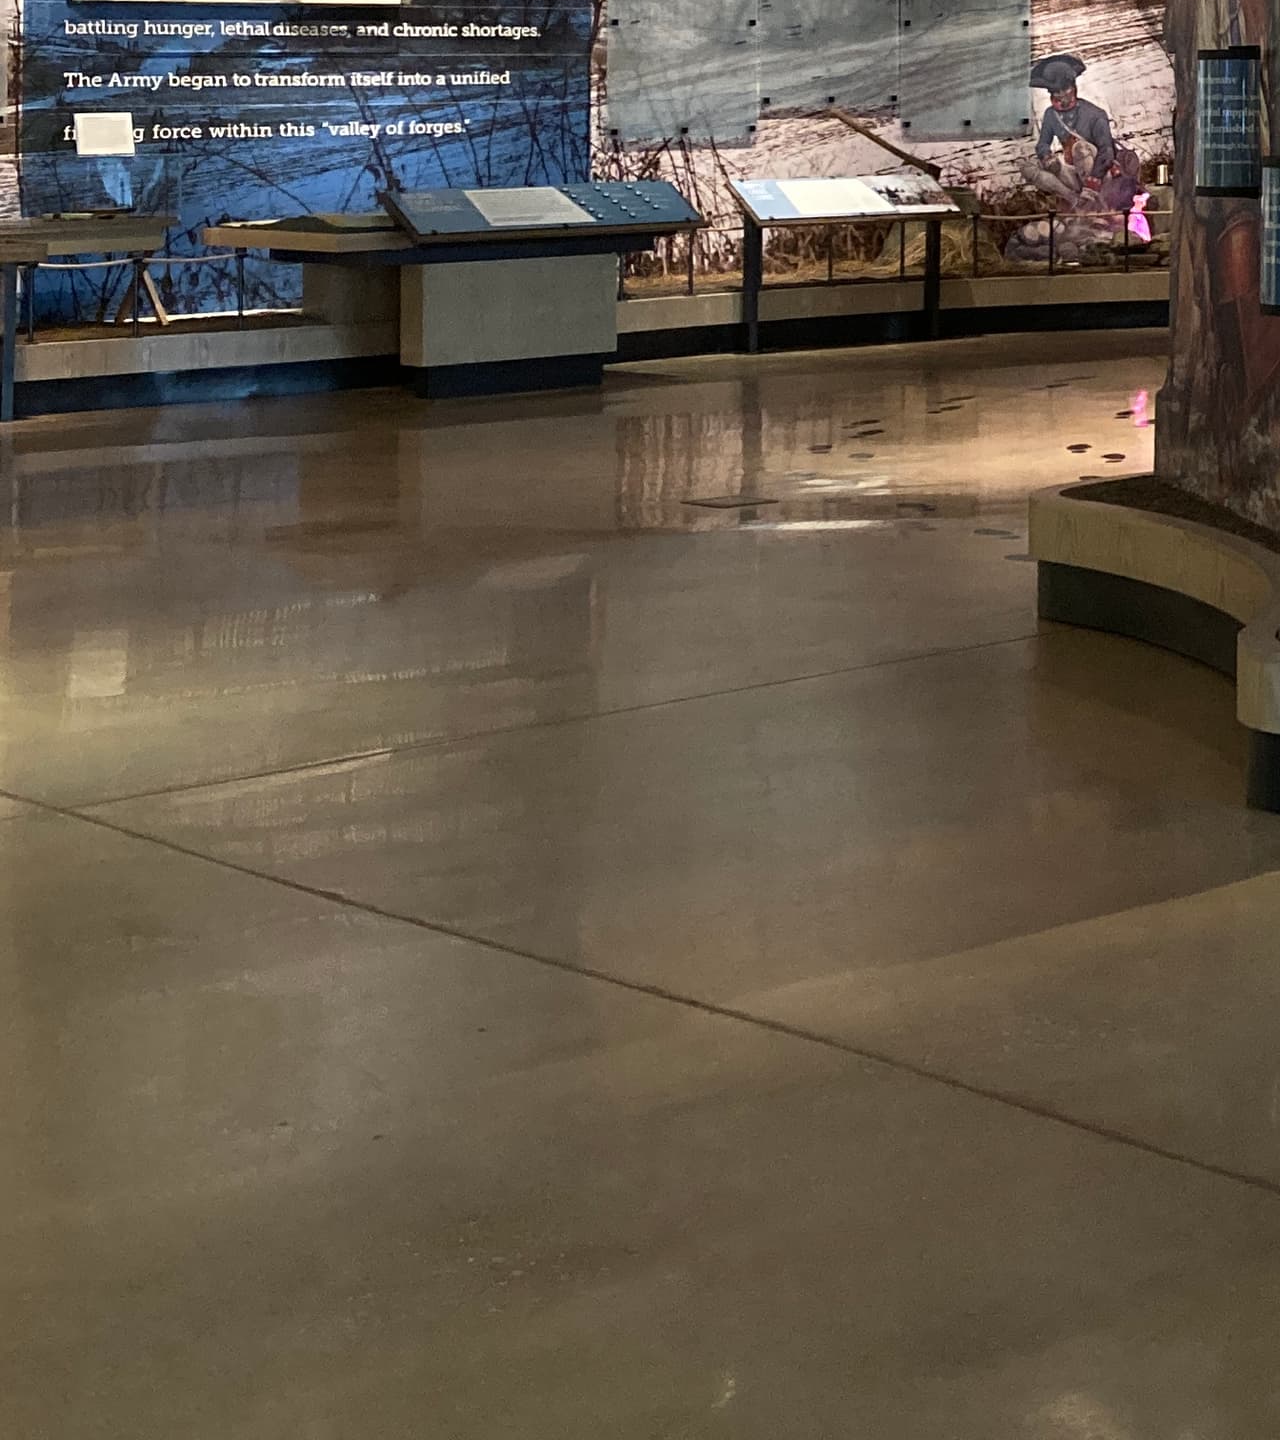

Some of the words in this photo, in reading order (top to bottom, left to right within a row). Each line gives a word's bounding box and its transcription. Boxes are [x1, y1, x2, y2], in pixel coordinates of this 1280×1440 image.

[64, 20, 138, 37] battling
[220, 21, 270, 36] lethal
[356, 22, 389, 37] and
[392, 22, 458, 37] chronic
[63, 72, 102, 88] The
[108, 73, 163, 91] Army
[168, 72, 227, 90] began
[231, 72, 251, 87] to
[254, 71, 345, 88] transform
[350, 71, 394, 87] itself
[397, 71, 432, 86] into
[435, 74, 446, 85] a
[448, 70, 511, 85] unified
[152, 123, 202, 139] force
[209, 122, 273, 139] within
[279, 122, 315, 137] this
[386, 120, 404, 136] of
